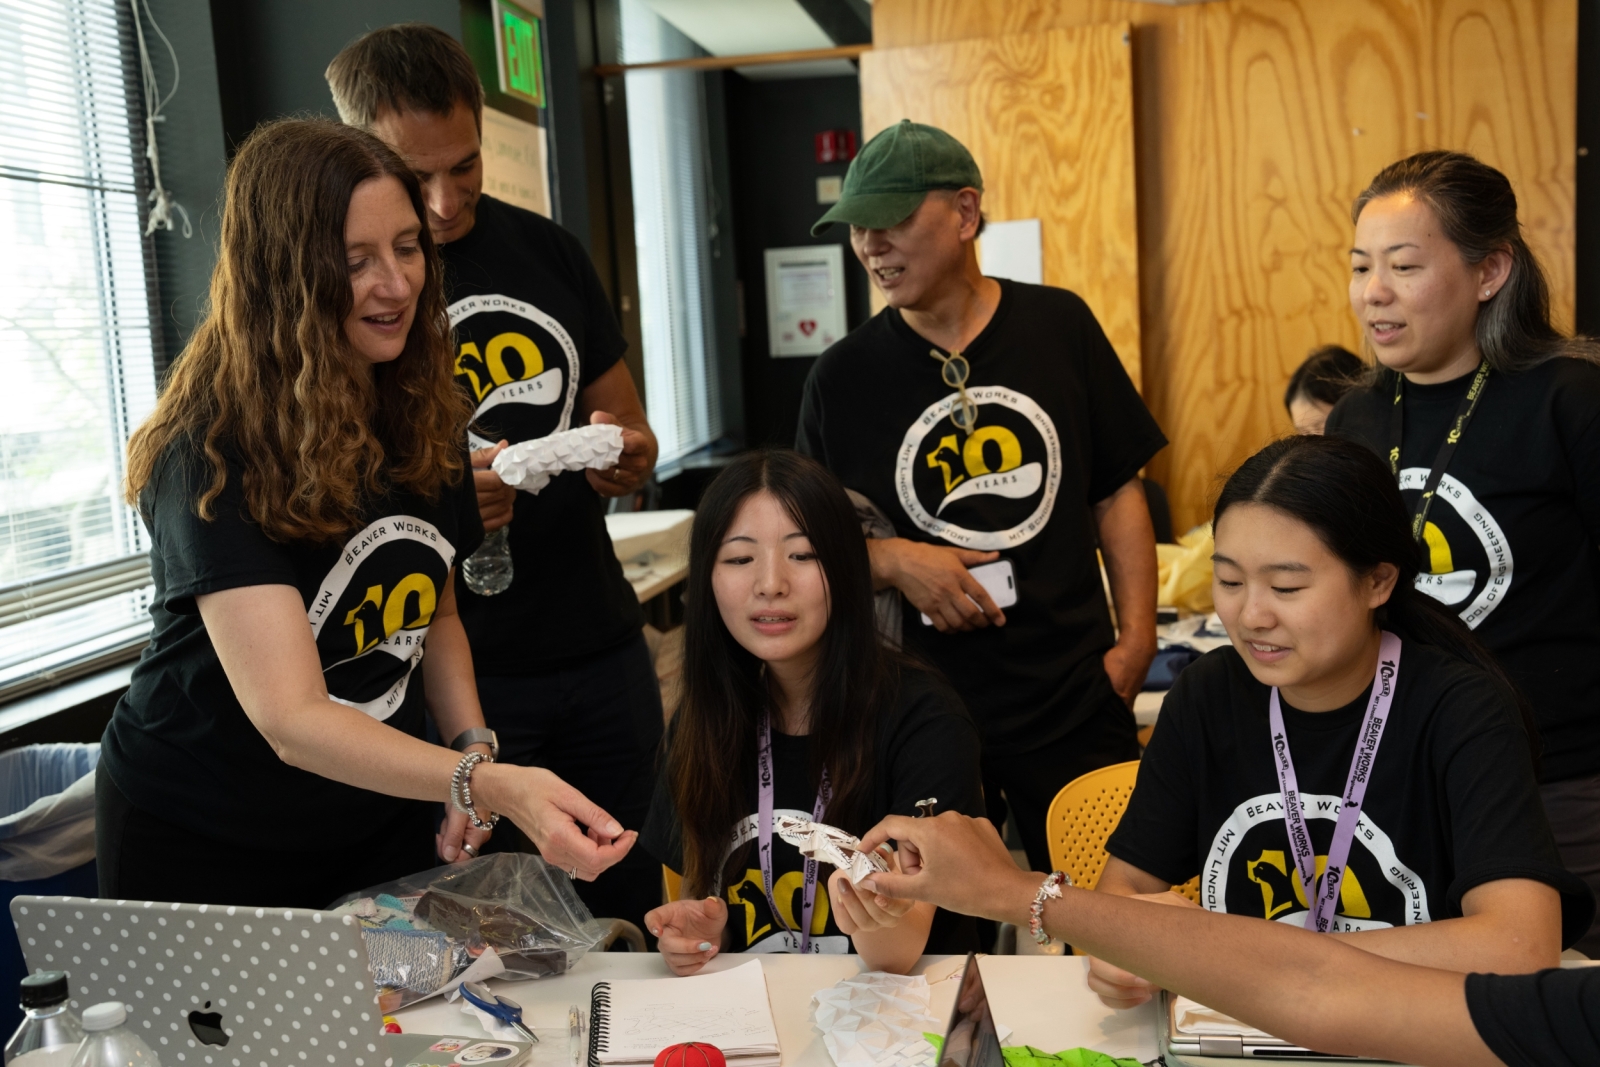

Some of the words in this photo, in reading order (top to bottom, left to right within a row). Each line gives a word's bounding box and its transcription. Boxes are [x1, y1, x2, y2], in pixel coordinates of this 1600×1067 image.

[448, 301, 476, 320] AVER
[480, 299, 526, 313] WORKS
[501, 381, 543, 399] YEARS
[1467, 373, 1484, 400] BEAVER
[923, 400, 953, 425] BEAV
[973, 391, 1018, 404] WORKS
[902, 443, 913, 463] MIT
[900, 467, 915, 512] LINCOLN
[975, 475, 1018, 490] YEARS
[1420, 474, 1461, 499] WRKS
[916, 513, 971, 543] LABOTORY
[1009, 528, 1025, 541] MIT
[345, 526, 387, 565] BEAVER
[393, 521, 437, 542] WORKS
[1474, 512, 1506, 586] ENGINEERING
[1416, 576, 1443, 585] ARS
[315, 590, 333, 618] MIT
[1466, 604, 1489, 623] OOL
[1487, 587, 1498, 602] OF
[1381, 660, 1395, 678] 10
[386, 688, 399, 708] MIT
[1274, 732, 1285, 751] 10
[1365, 717, 1383, 751] BEAVER
[761, 771, 771, 788] 10
[1357, 752, 1373, 783] WORKS
[1246, 801, 1305, 818] BEAVR
[1317, 801, 1374, 840] WOKS
[1288, 790, 1301, 824] BEAVER
[1295, 825, 1311, 857] WORKS
[1217, 829, 1235, 856] MIT
[1208, 860, 1222, 912] LINCOL
[1327, 865, 1341, 884] 10
[1390, 866, 1423, 925] INEERING
[1317, 917, 1329, 933] BEA
[1333, 920, 1361, 933] ARS
[783, 936, 820, 953] YERS
